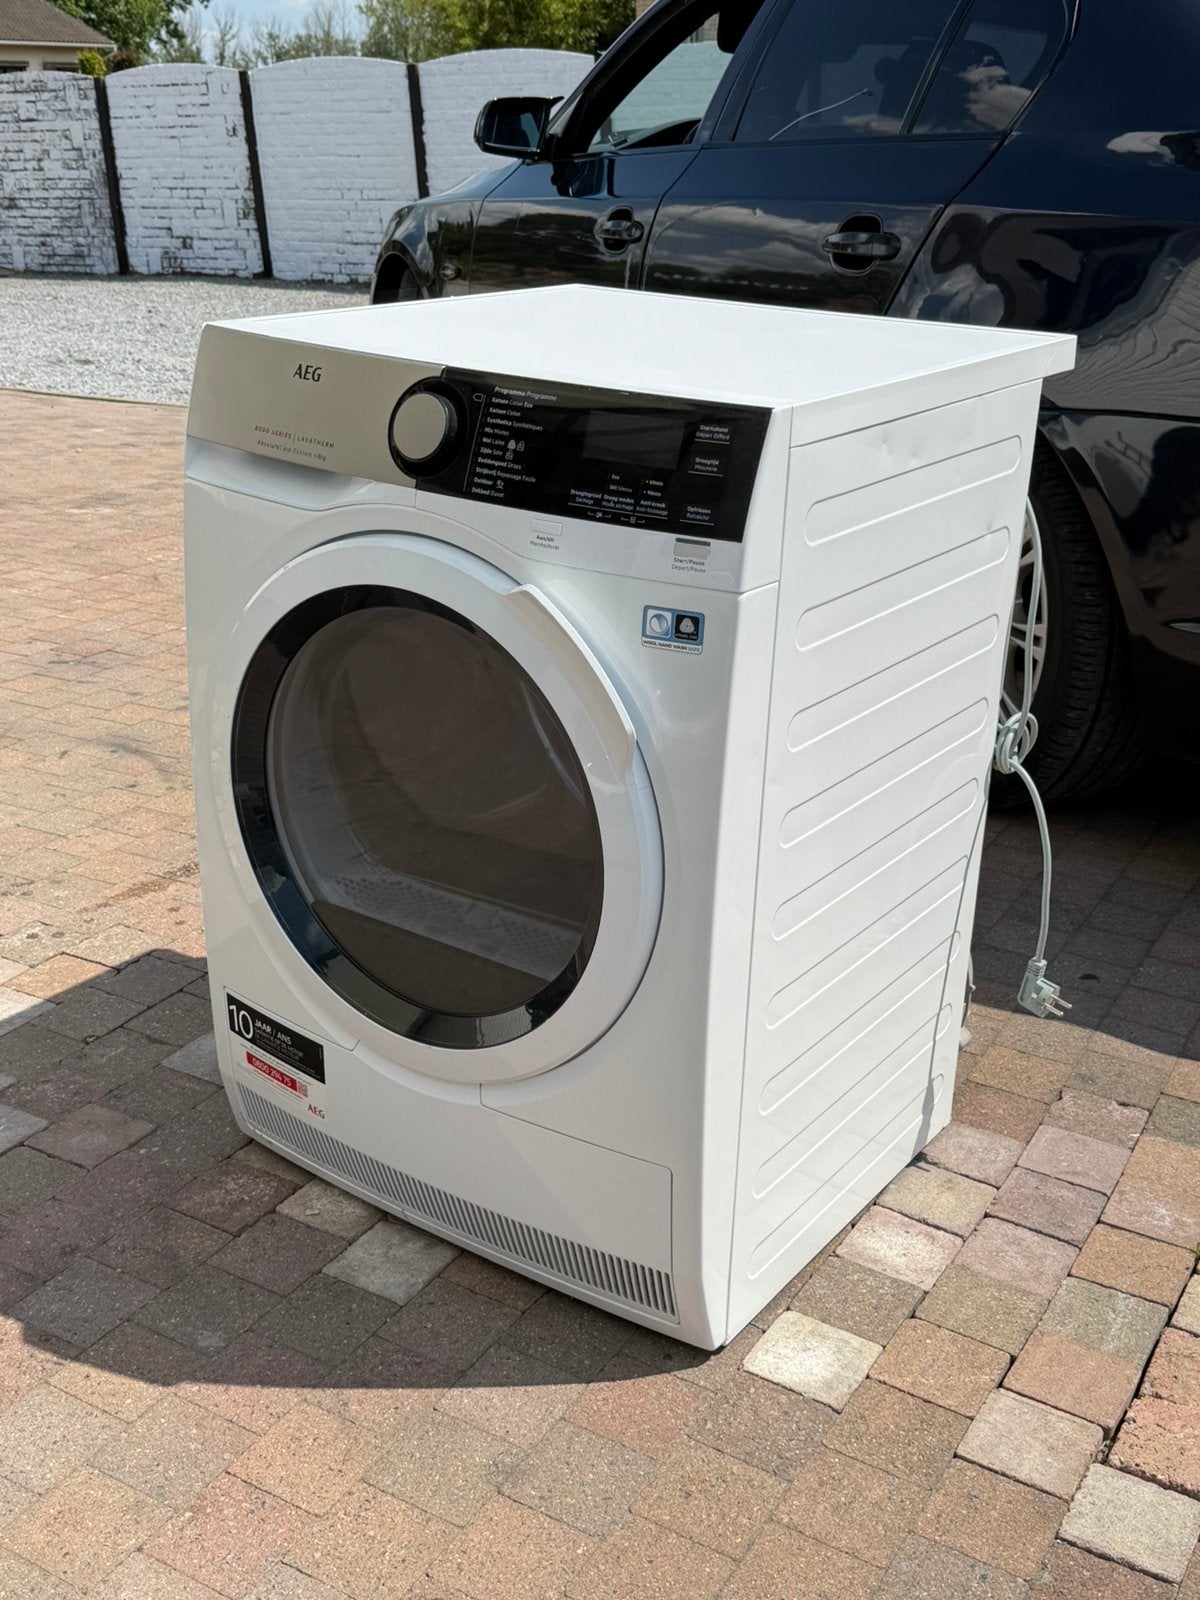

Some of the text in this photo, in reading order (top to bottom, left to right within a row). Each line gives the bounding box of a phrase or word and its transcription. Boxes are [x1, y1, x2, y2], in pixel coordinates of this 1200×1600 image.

[293, 364, 322, 382] AEG
[494, 386, 557, 401] Programma Programme
[255, 425, 270, 434] 8000
[271, 430, 292, 440] SERIES
[297, 436, 335, 448] LAVATHERM
[293, 448, 312, 457] System
[673, 557, 706, 566] Start/Pause
[229, 1005, 254, 1039] 10
[255, 1019, 272, 1034] JAAR
[277, 1031, 292, 1045] ANS
[252, 1058, 270, 1074] 0800
[270, 1068, 282, 1080] 294
[307, 1103, 325, 1120] AEG
